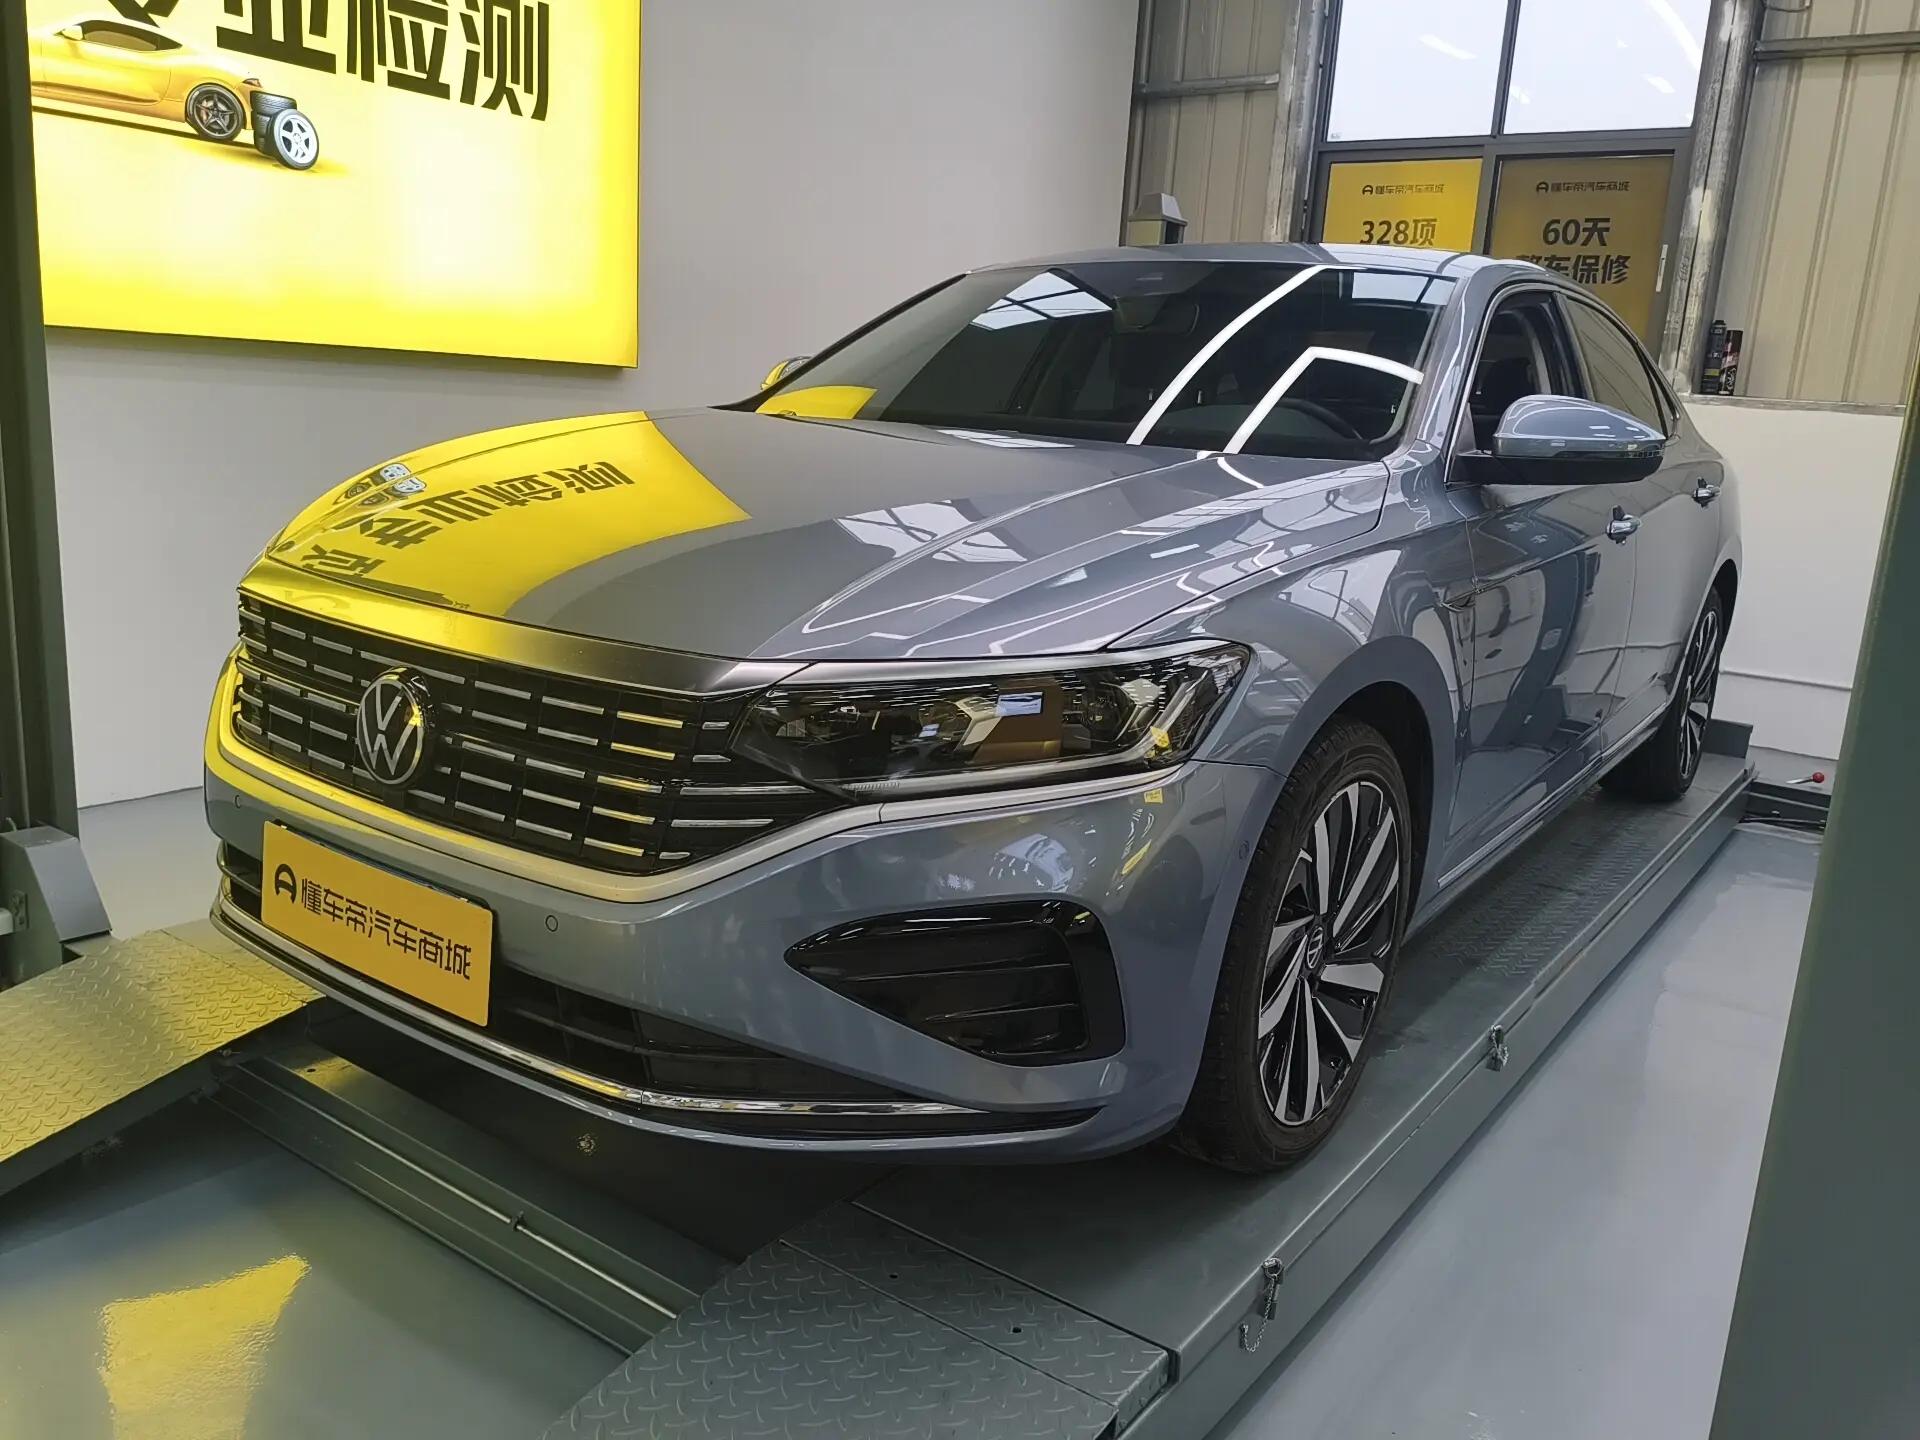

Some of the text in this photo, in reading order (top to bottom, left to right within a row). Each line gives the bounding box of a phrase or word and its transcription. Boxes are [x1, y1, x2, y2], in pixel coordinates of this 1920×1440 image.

[1360, 218, 1437, 246] 328项
[1542, 217, 1611, 247] 60天
[301, 877, 472, 980] 懂车帝汽车商城
